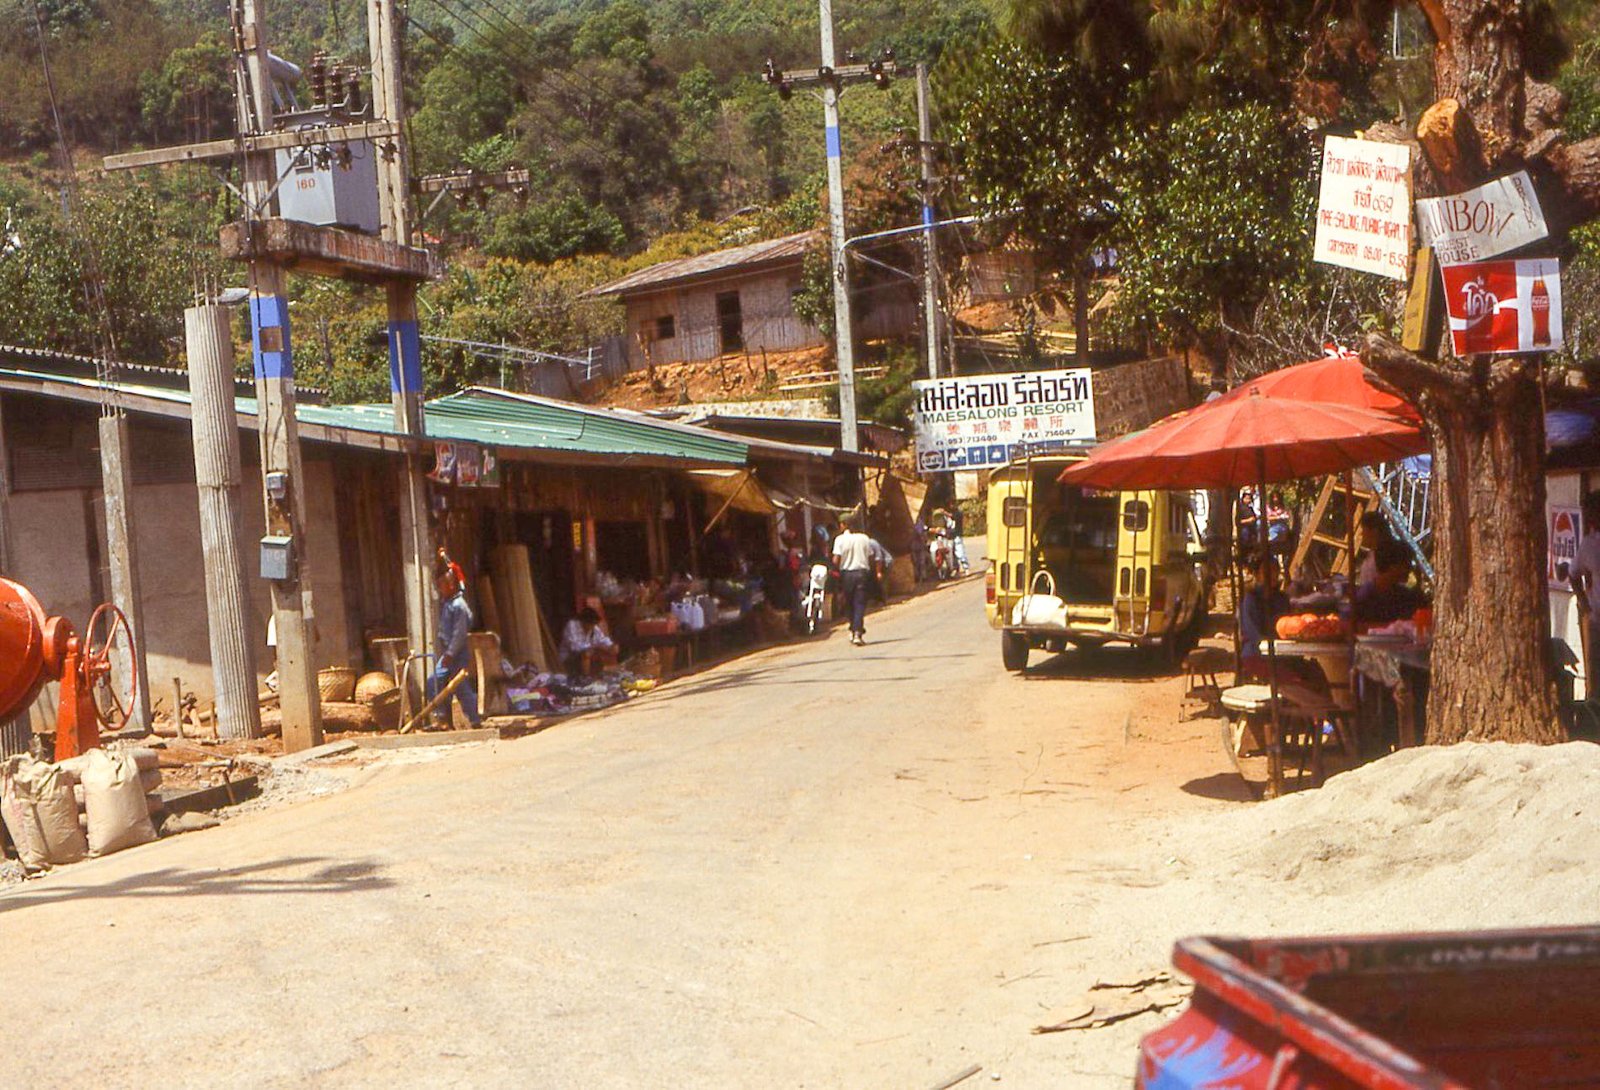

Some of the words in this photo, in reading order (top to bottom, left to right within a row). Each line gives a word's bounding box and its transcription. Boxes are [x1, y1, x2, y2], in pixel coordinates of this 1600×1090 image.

[296, 178, 315, 191] 160
[1437, 235, 1469, 251] GUEST
[1437, 245, 1480, 264] HOUSE
[1012, 371, 1088, 405] รีสอร์ท
[923, 406, 1018, 425] MAESALONG
[1024, 401, 1085, 417] RESORT
[1021, 431, 1040, 439] FAX
